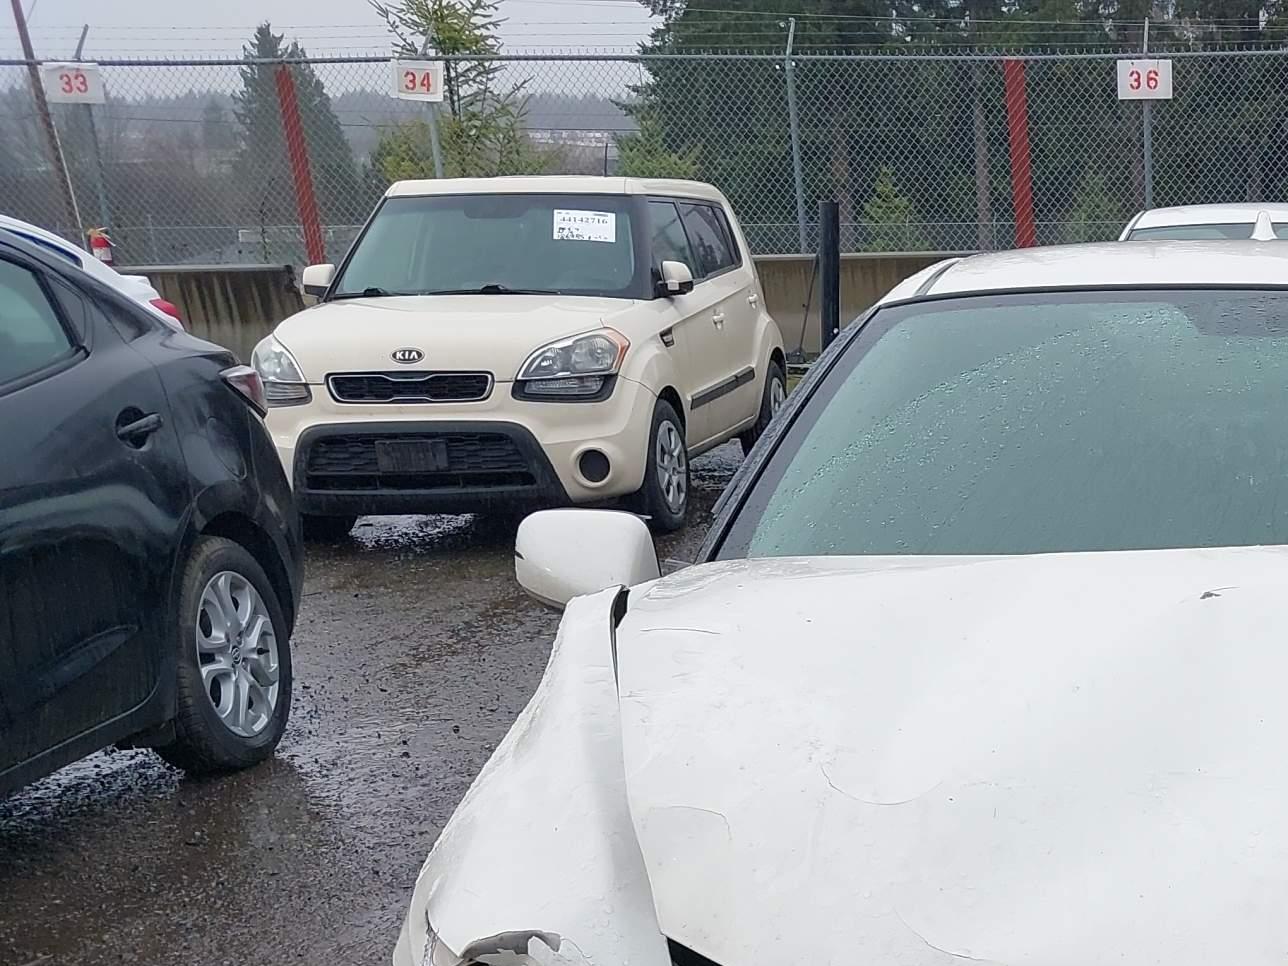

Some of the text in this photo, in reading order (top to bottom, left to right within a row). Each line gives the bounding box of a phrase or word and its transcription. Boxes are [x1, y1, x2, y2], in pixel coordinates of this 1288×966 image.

[60, 73, 88, 93] 33
[404, 71, 431, 92] 34
[1129, 70, 1159, 90] 36
[395, 350, 419, 360] KIA
